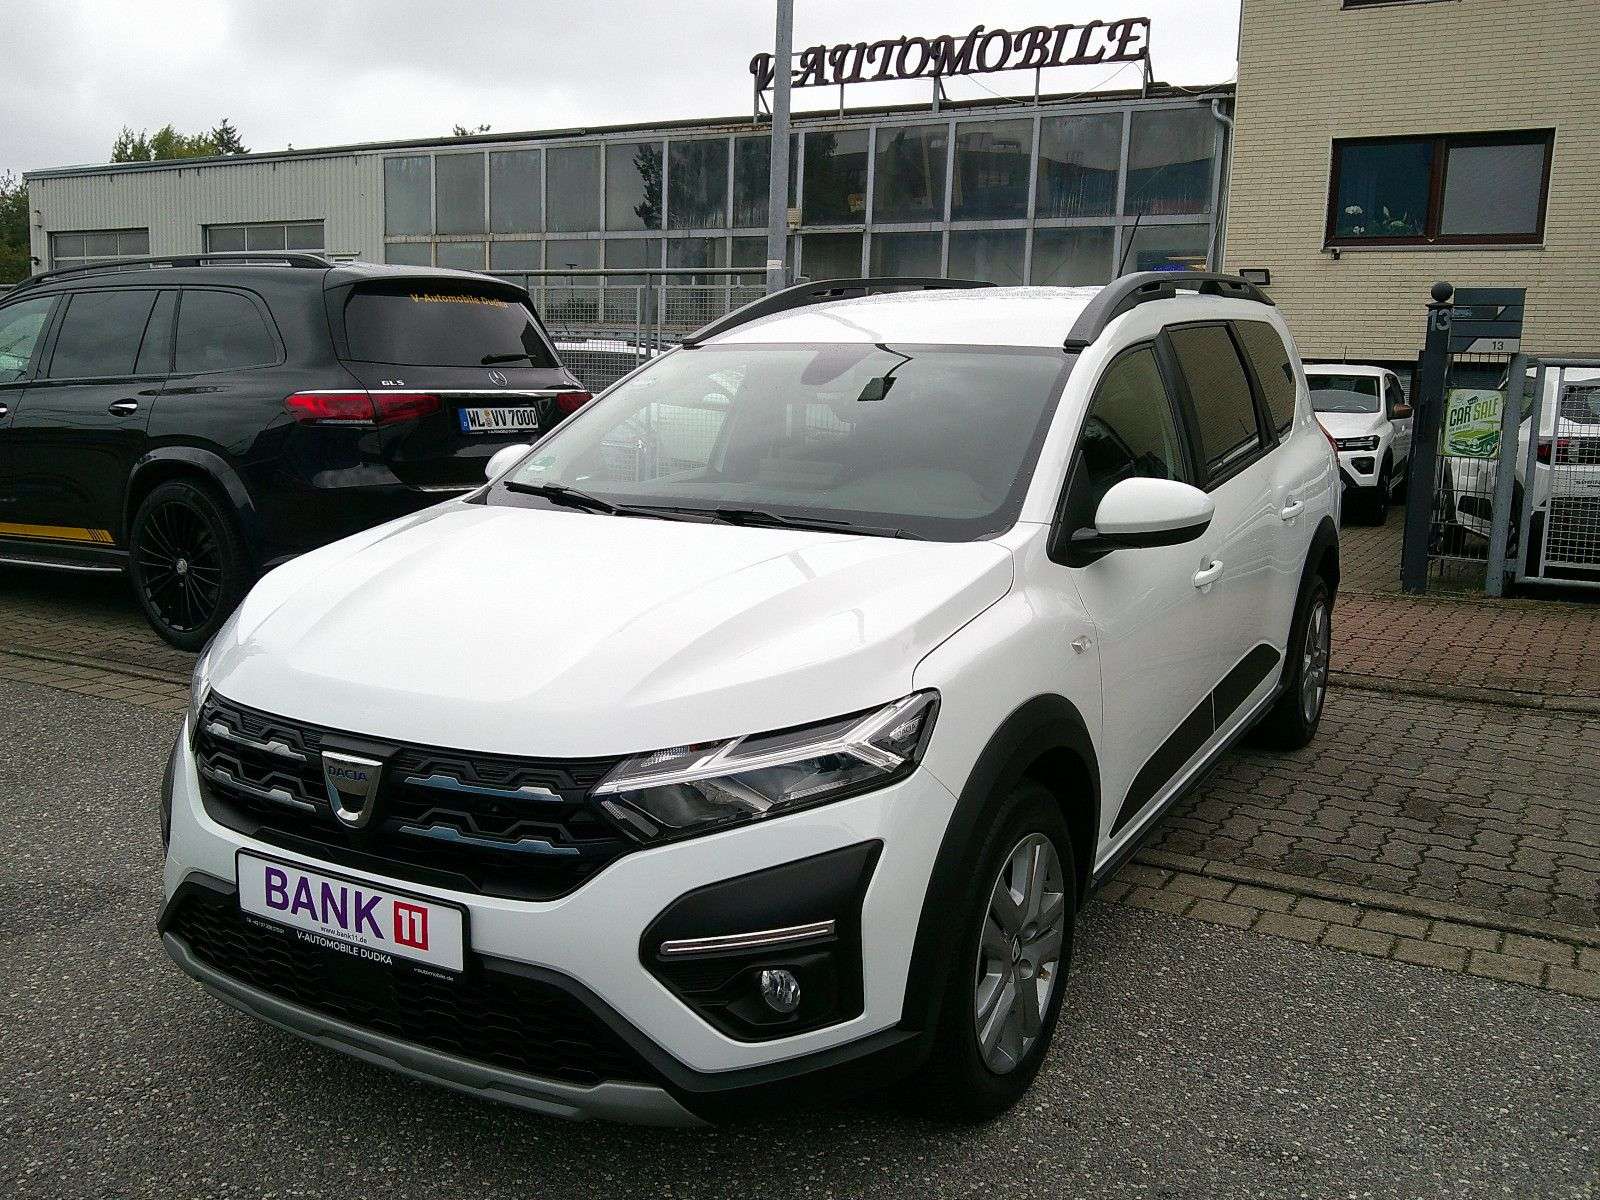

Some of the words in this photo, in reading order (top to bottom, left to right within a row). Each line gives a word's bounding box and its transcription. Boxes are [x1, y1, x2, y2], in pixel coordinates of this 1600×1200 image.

[749, 17, 1148, 91] V-AUTOMOBILE
[410, 294, 480, 304] V-Automobile
[1428, 308, 1452, 332] 13
[1492, 341, 1504, 351] 13
[468, 410, 485, 427] WL
[491, 409, 507, 427] VV
[508, 409, 537, 426] 7000
[1450, 405, 1471, 427] CAR
[1473, 397, 1499, 421] SALE
[328, 765, 368, 781] DACIA
[265, 865, 385, 940] BANK
[399, 908, 423, 944] 11
[320, 926, 368, 945] www.bank11.de
[296, 930, 359, 956] V-AUTOMOBILE
[360, 949, 393, 966] DUDKA
